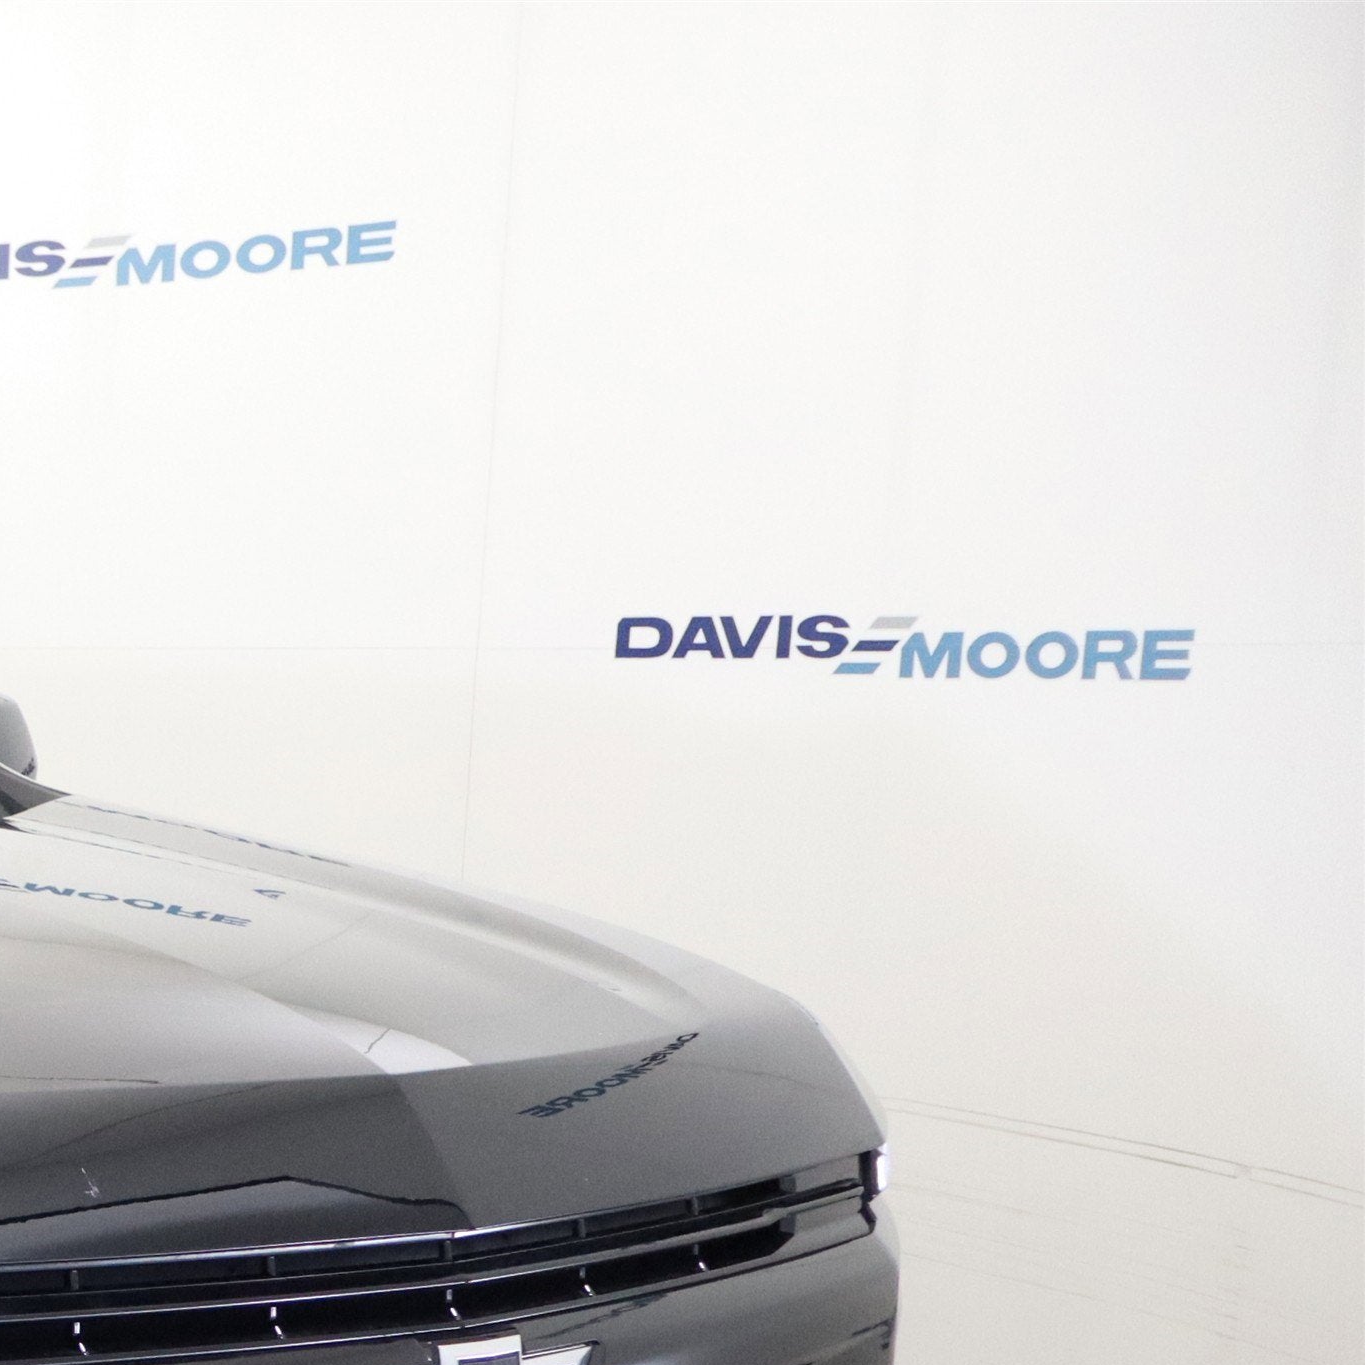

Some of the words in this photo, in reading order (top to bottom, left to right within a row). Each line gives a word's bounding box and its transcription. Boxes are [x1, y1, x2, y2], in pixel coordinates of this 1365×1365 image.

[116, 220, 397, 287] MOORE
[614, 614, 850, 660] DAVIS
[898, 629, 1196, 681] MOORE
